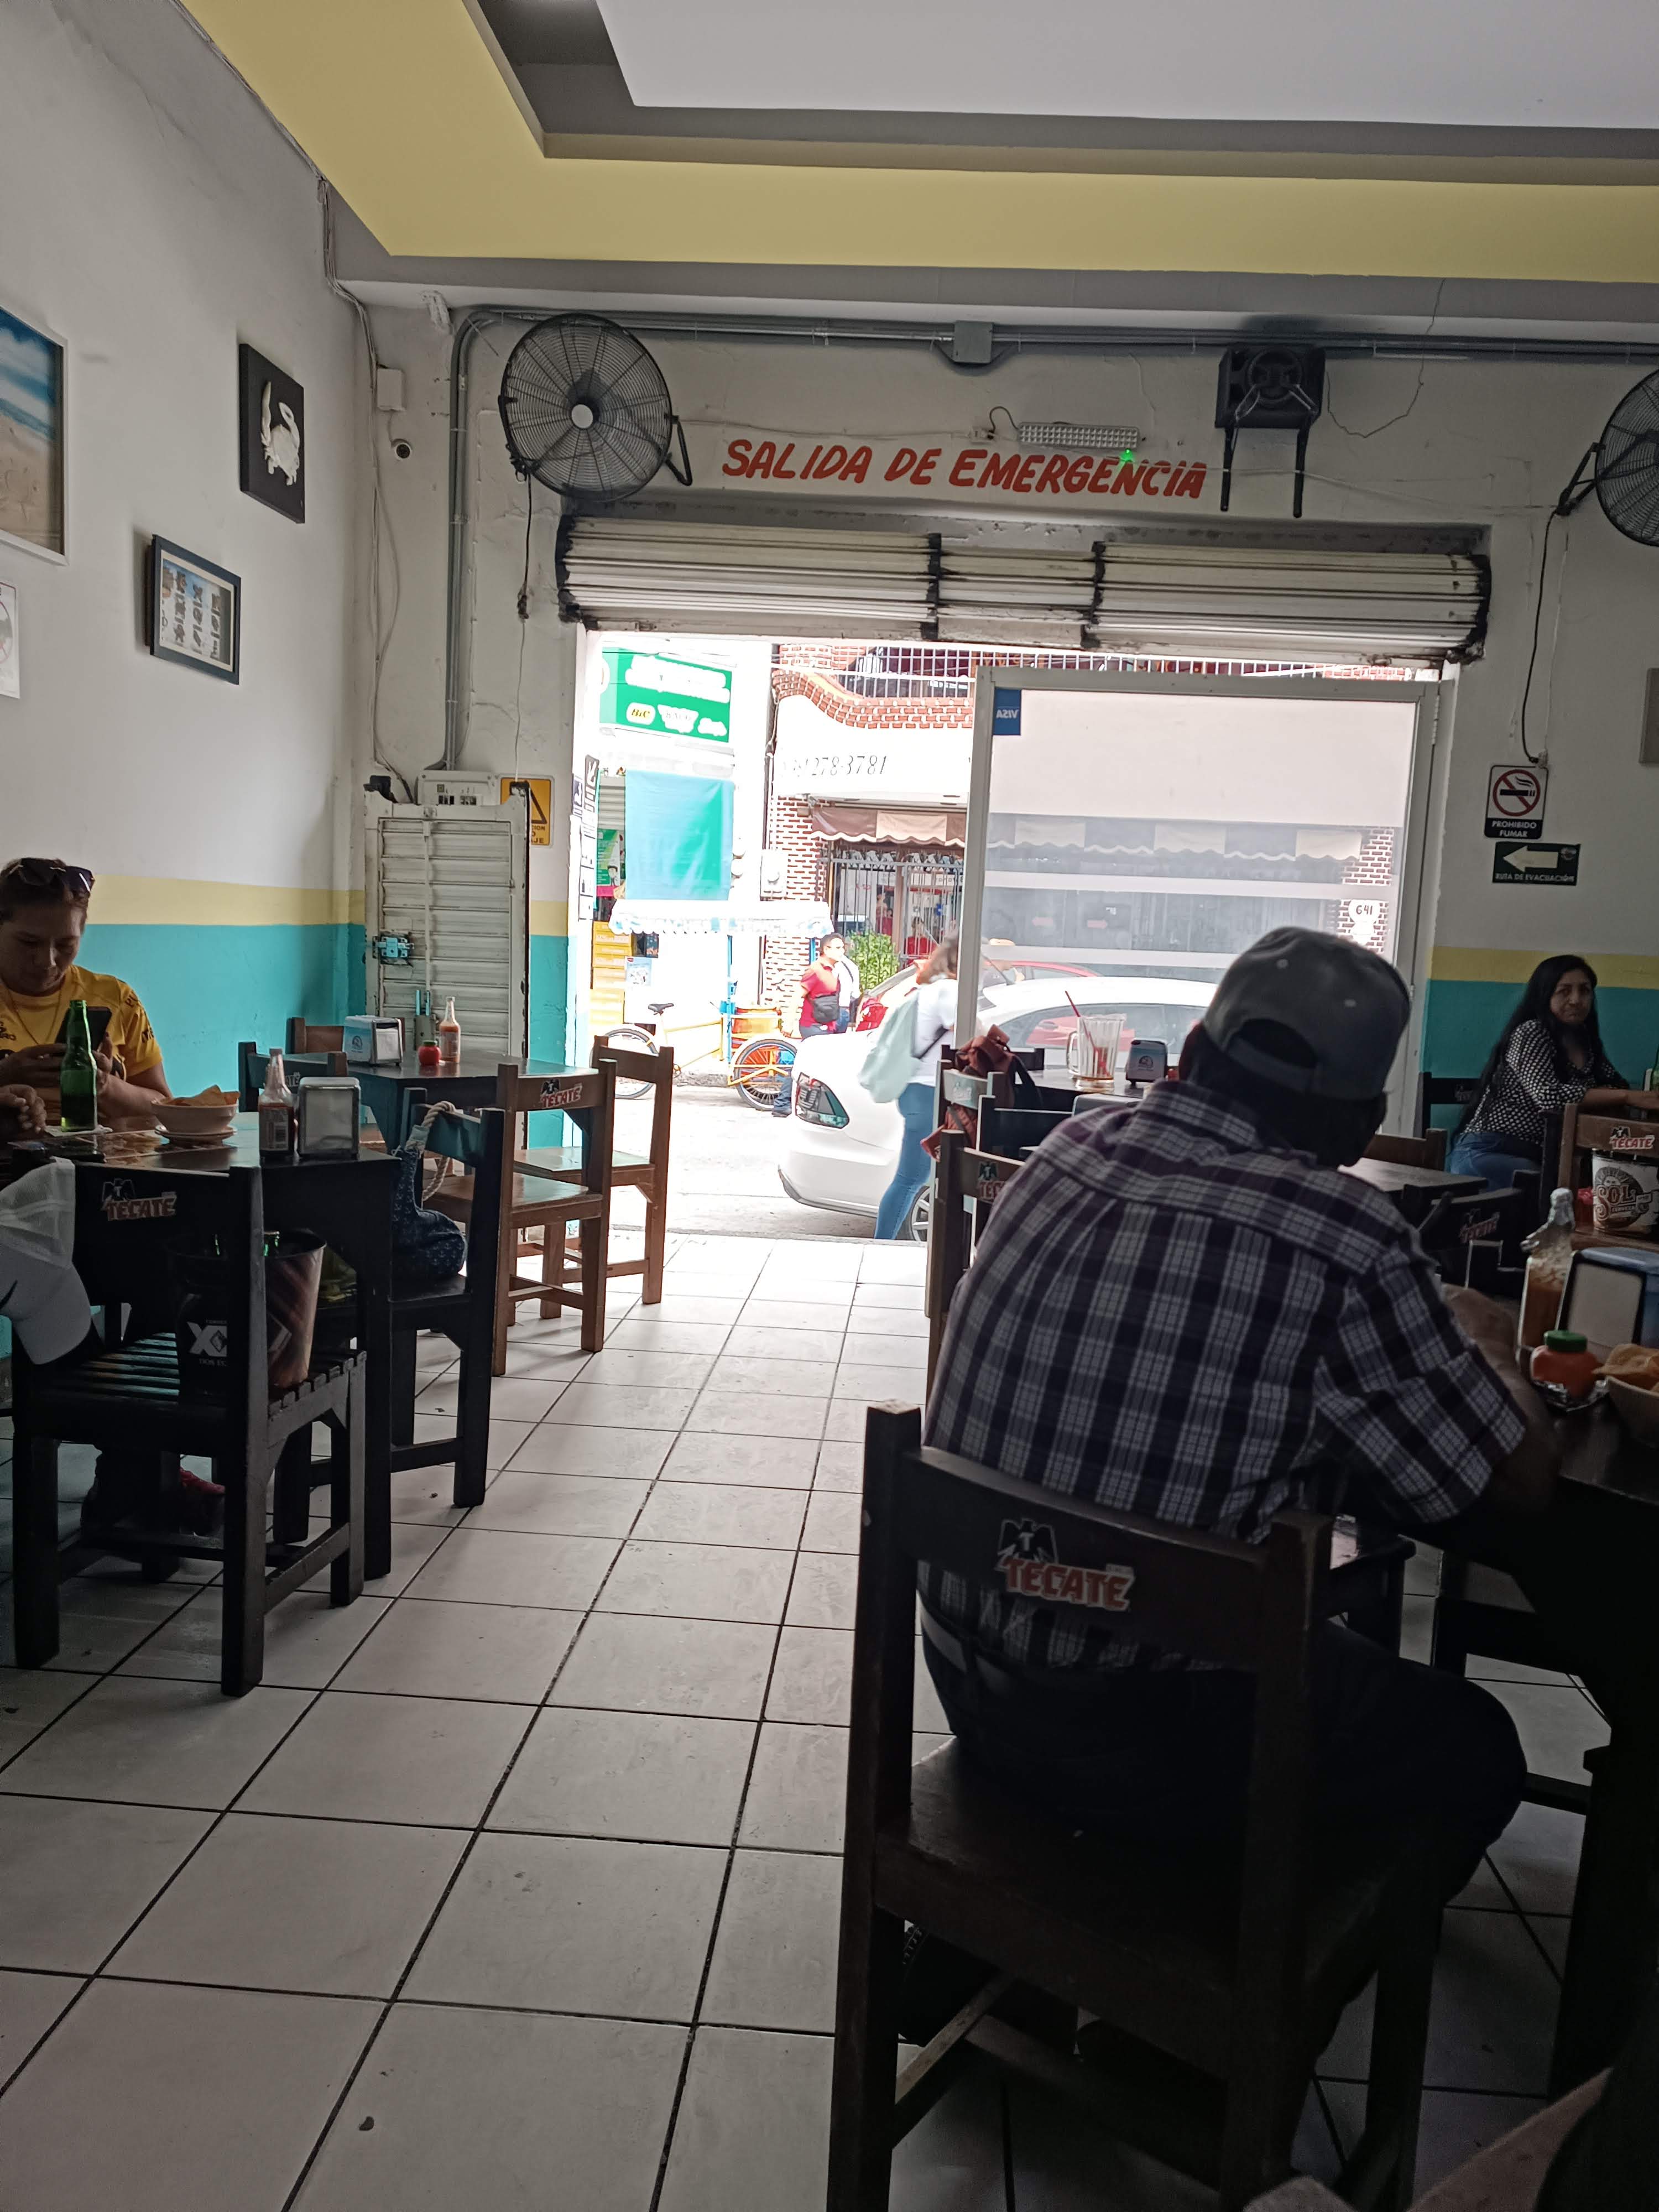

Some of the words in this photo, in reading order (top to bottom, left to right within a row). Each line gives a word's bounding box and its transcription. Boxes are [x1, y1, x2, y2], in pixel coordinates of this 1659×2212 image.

[722, 439, 873, 484] SALIDA
[884, 448, 942, 485] DE
[949, 449, 1207, 499] EMERGENCIA
[1491, 820, 1537, 829] PROHIBIDO
[1499, 830, 1527, 838] FUMAR
[1356, 905, 1373, 915] 641
[540, 1087, 582, 1108] TECATE
[1611, 1137, 1653, 1150] TECATE
[106, 1197, 176, 1220] TECATE
[1596, 1185, 1636, 1220] SOL
[1000, 1556, 1134, 1611] TECATE
